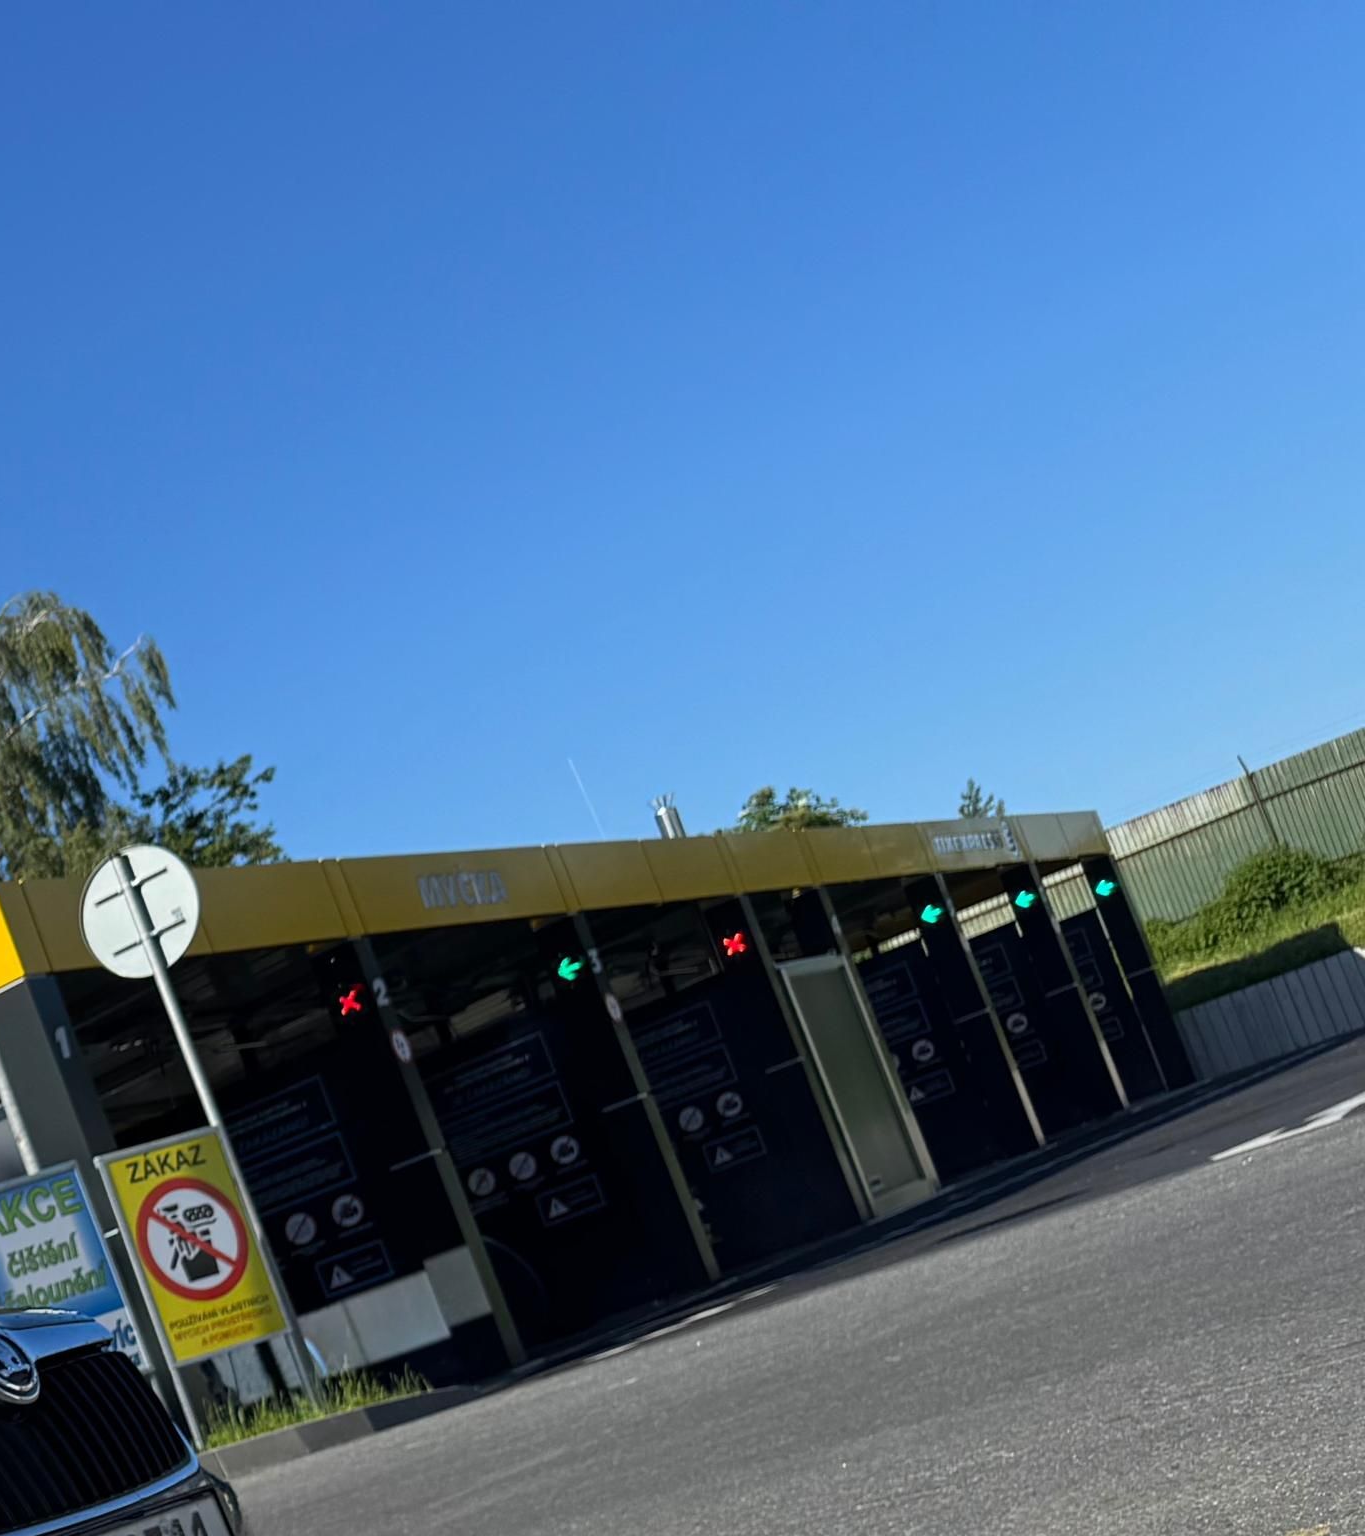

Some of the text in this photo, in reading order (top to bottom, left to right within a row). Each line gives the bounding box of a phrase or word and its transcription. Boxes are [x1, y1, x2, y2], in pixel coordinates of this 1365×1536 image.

[587, 948, 603, 974] 3
[372, 977, 389, 1008] 2
[54, 1025, 71, 1060] 1
[126, 1144, 206, 1184] ZÁKAZ
